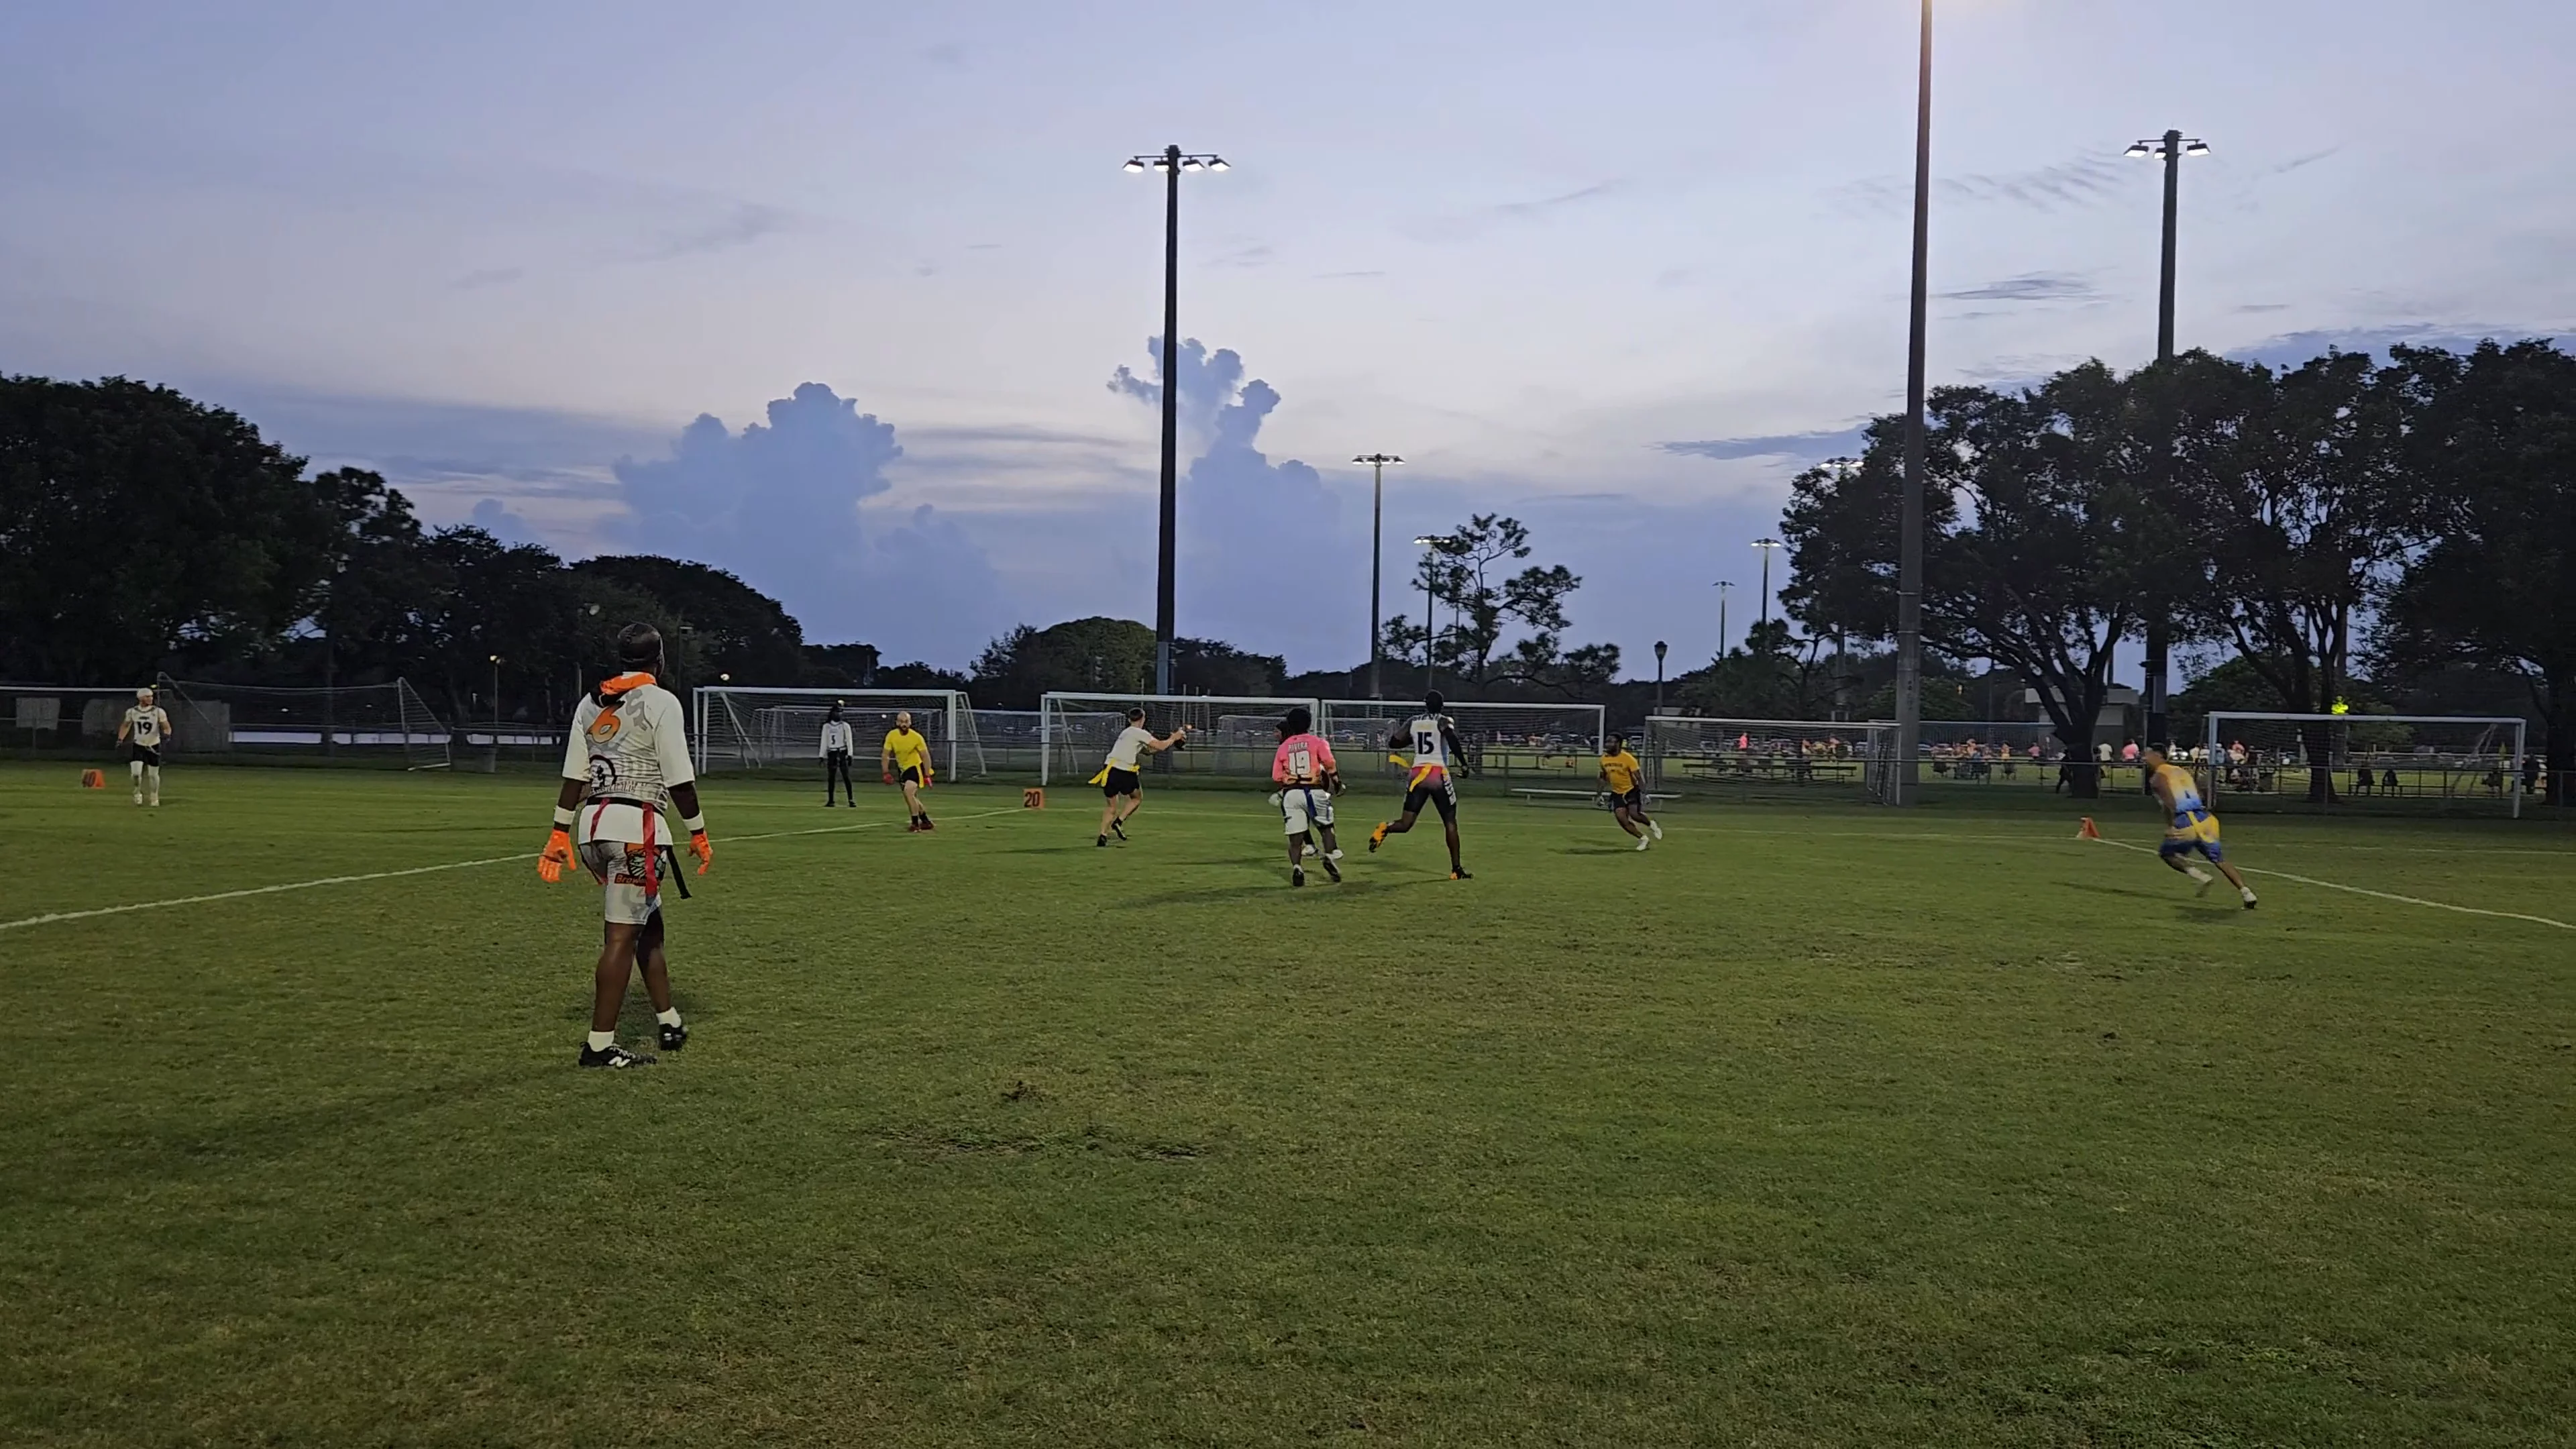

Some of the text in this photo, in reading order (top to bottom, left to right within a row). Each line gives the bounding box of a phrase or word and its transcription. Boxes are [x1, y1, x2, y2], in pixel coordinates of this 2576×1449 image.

[137, 721, 153, 735] 19
[586, 702, 625, 744] 6
[1288, 742, 1307, 751] RIVERA
[1417, 732, 1434, 754] 15
[1289, 751, 1310, 774] 19
[1024, 792, 1040, 807] 20
